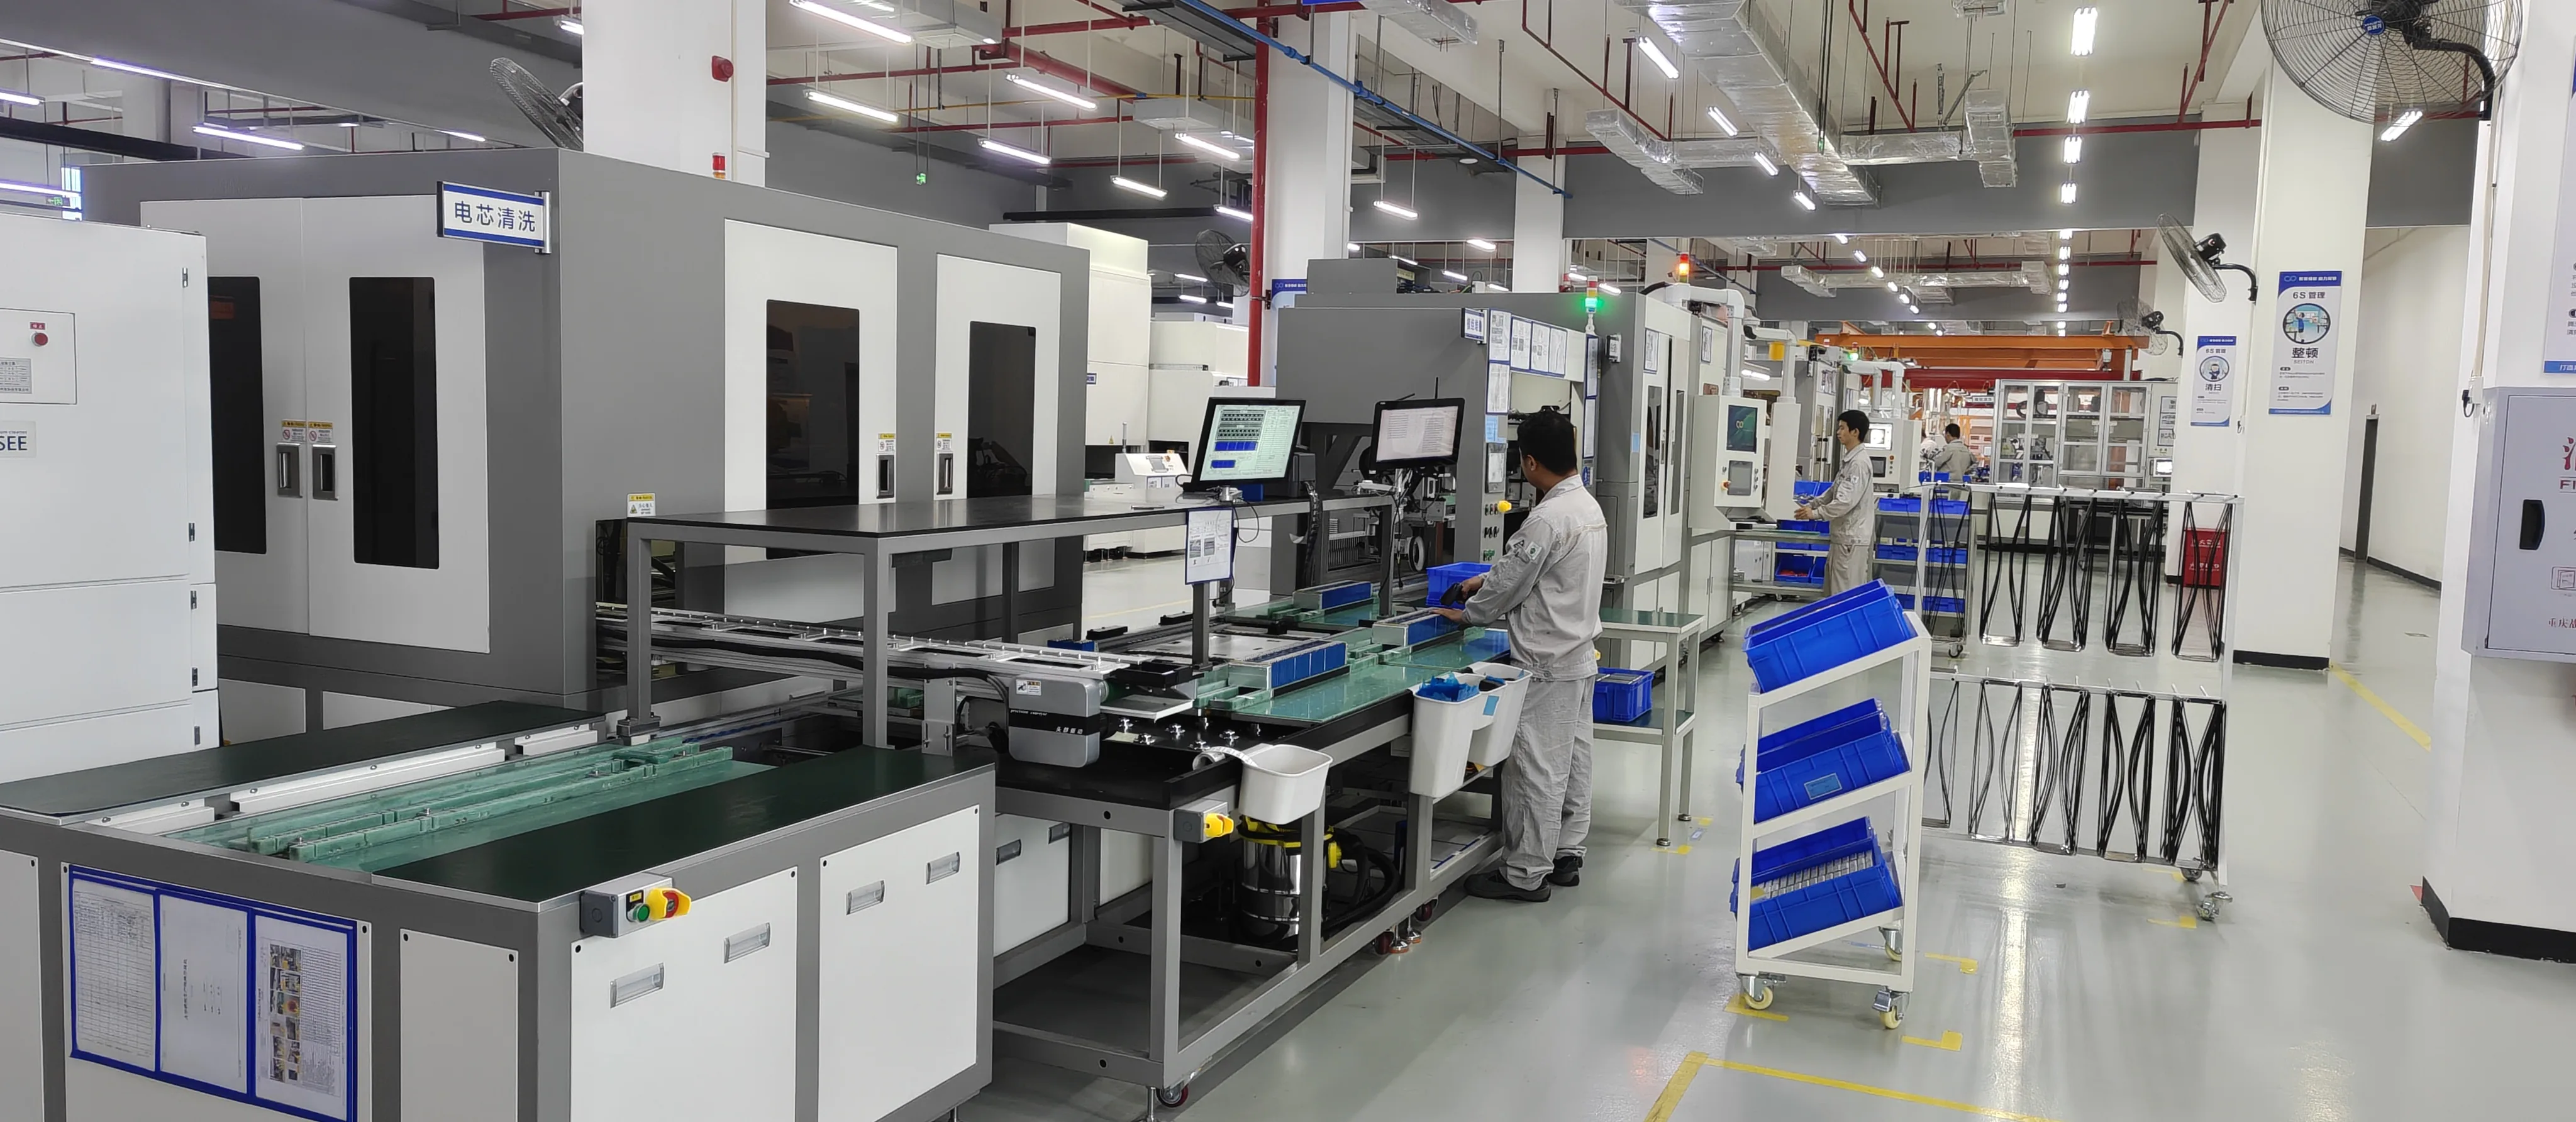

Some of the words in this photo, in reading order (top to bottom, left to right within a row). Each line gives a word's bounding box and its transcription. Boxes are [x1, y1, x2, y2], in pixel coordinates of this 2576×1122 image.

[454, 201, 535, 232] 电芯清洗
[2291, 347, 2319, 358] 整顿
